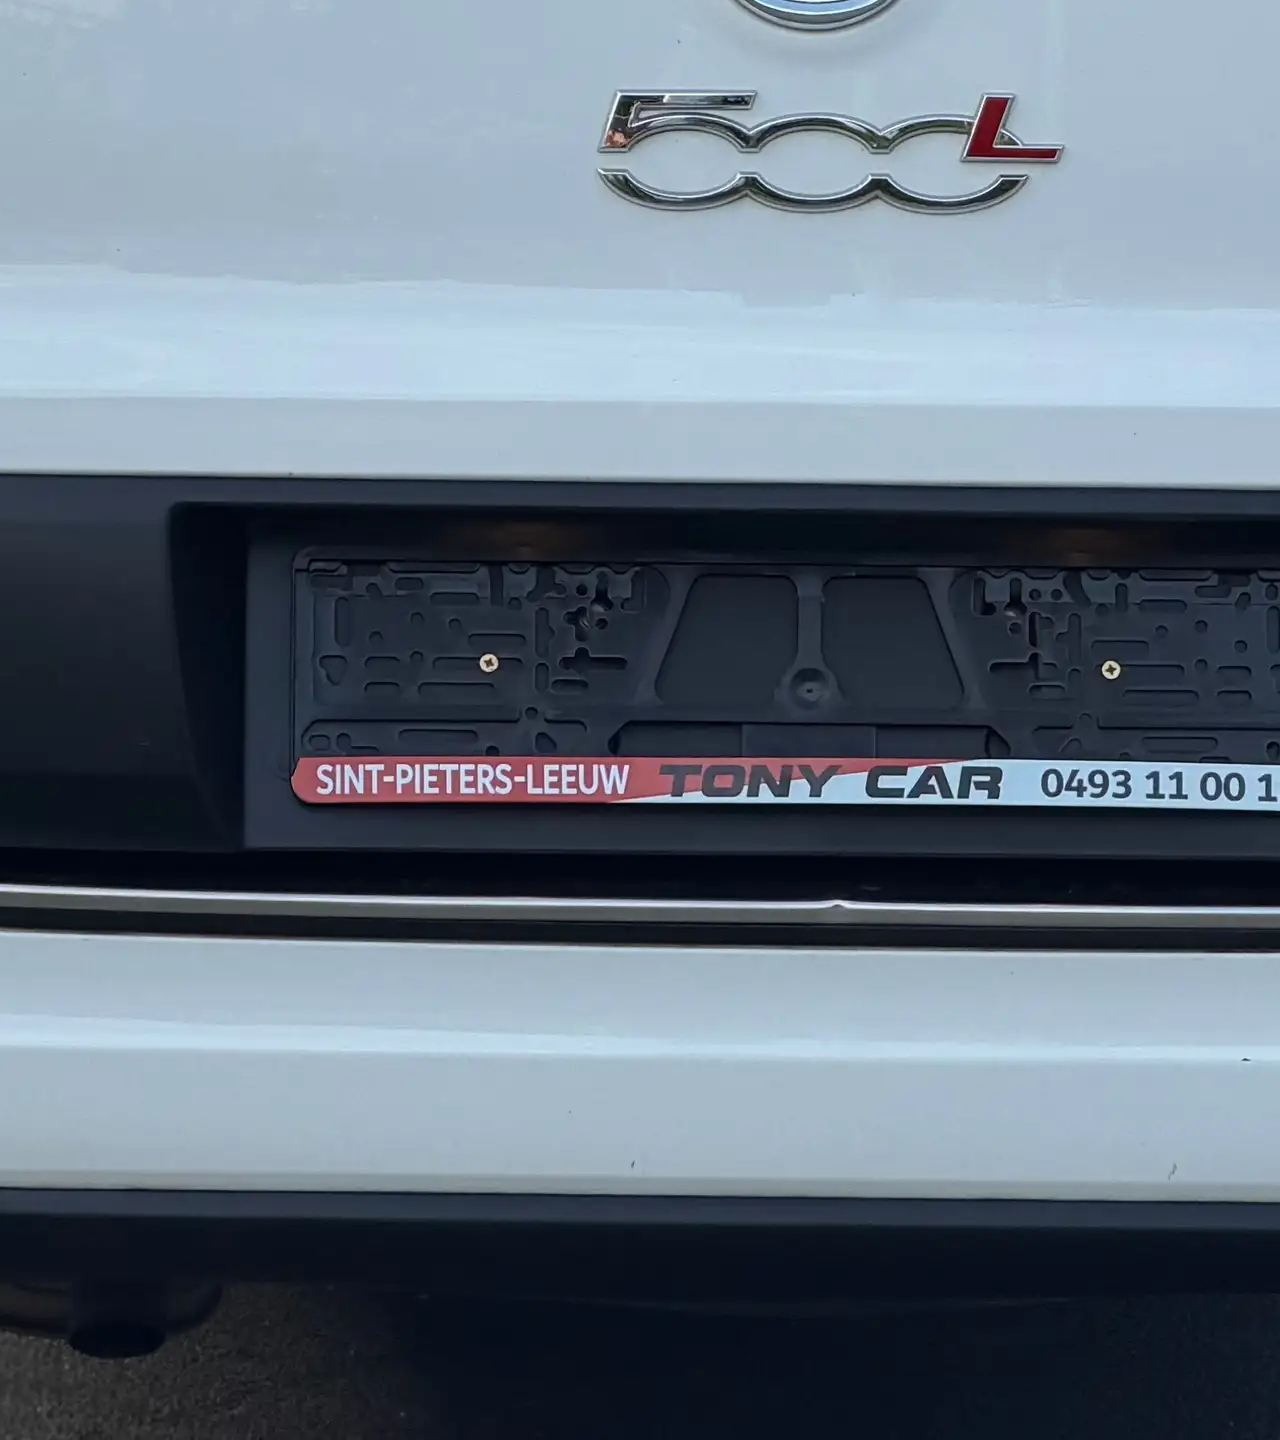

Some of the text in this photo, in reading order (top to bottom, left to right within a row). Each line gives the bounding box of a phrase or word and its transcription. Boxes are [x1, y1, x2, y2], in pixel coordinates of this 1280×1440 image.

[596, 89, 1065, 214] 500L
[315, 763, 630, 796] SINT-PIETERS-LEEUW
[658, 763, 842, 798] TONY
[864, 765, 1004, 800] CAR
[1040, 768, 1134, 800] 0493
[1144, 770, 1189, 800] 11
[1199, 771, 1247, 802] 00
